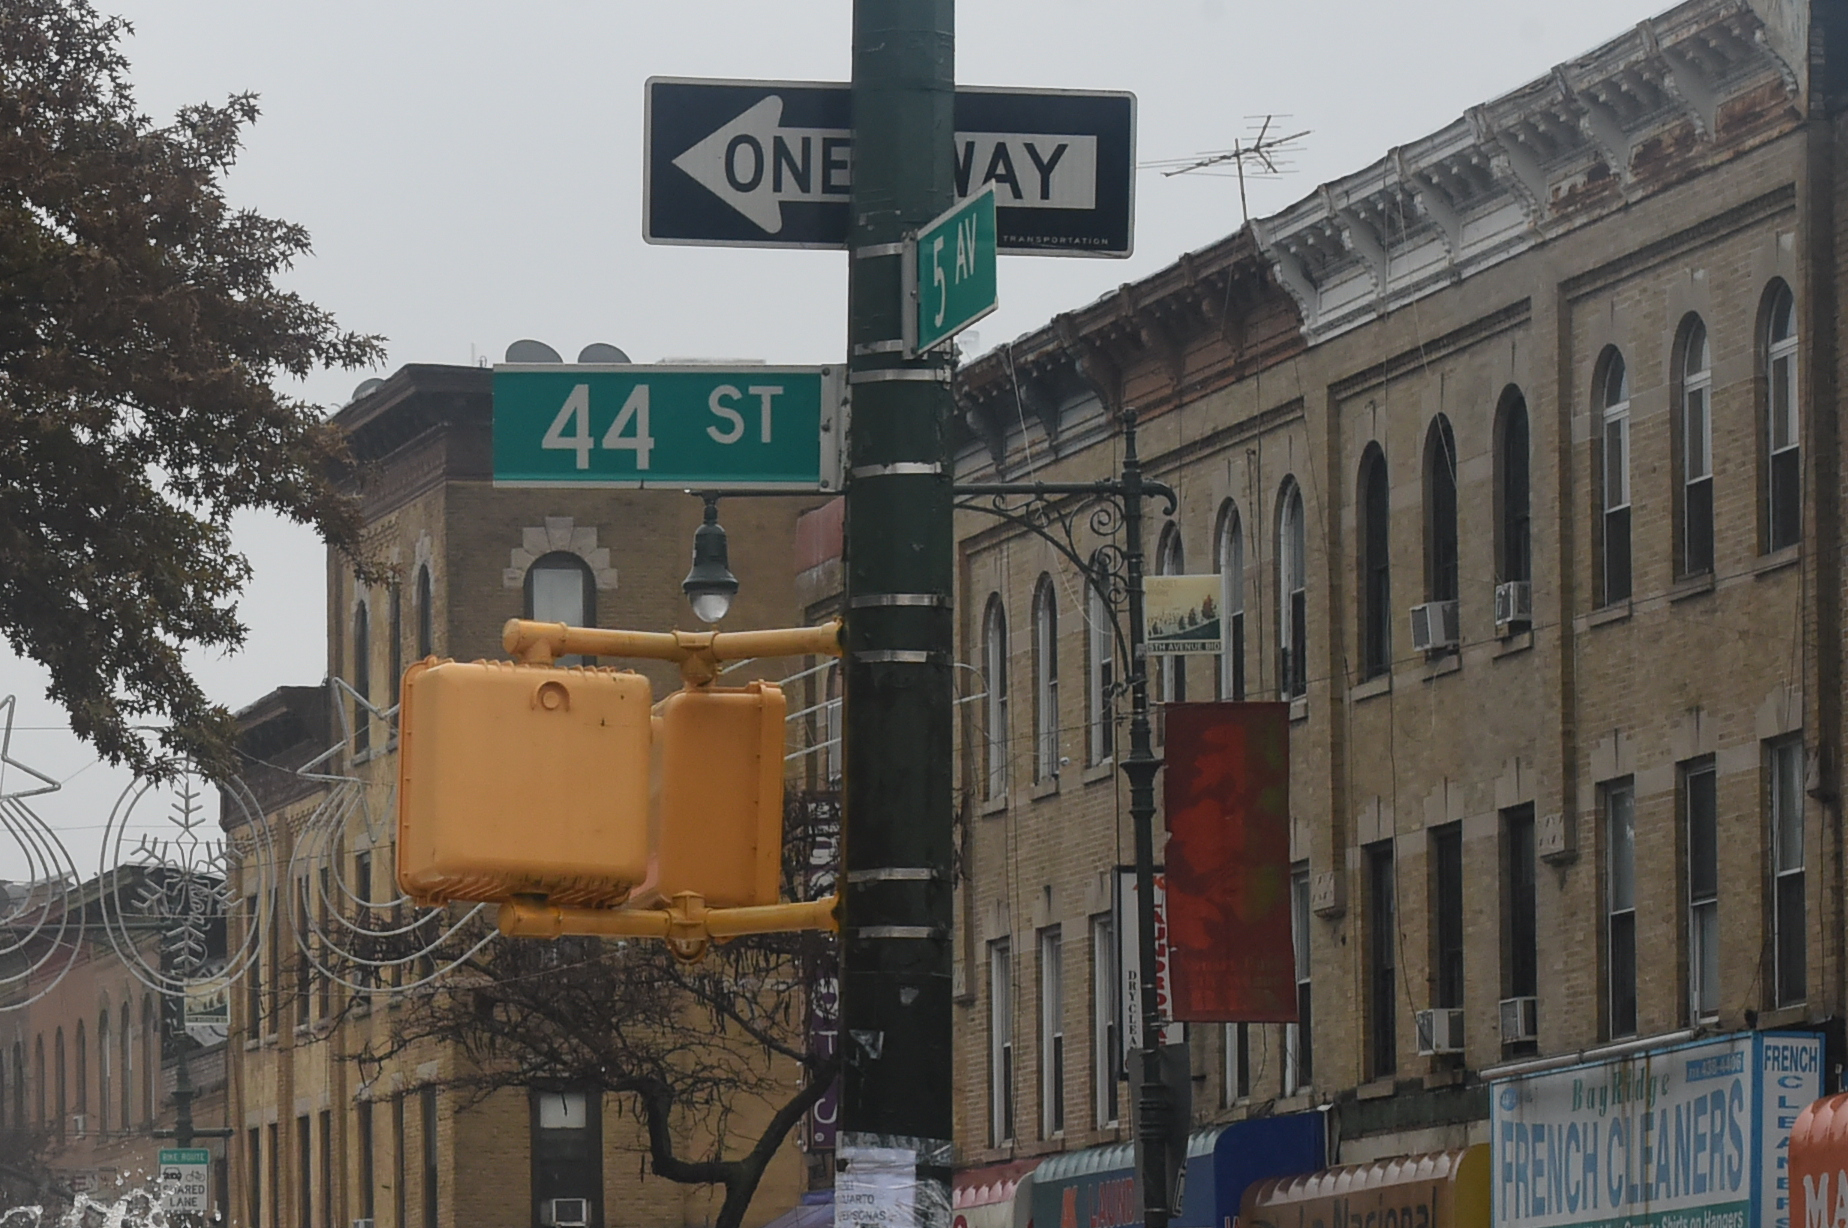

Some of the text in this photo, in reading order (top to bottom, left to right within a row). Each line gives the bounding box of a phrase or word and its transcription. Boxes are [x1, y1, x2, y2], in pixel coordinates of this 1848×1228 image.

[724, 133, 852, 194] ONE
[1003, 235, 1109, 246] TRANSPORTATION
[932, 212, 978, 329] 5 AV
[540, 383, 784, 471] 44 ST
[1167, 643, 1203, 651] AVENUE
[1764, 1043, 1818, 1074] FRENCH
[162, 1153, 206, 1163] BIKE ROUTE
[1500, 1077, 1745, 1222] FRENCH CLEANERS
[169, 1196, 198, 1207] LANE
[841, 1193, 875, 1205] UARTO
